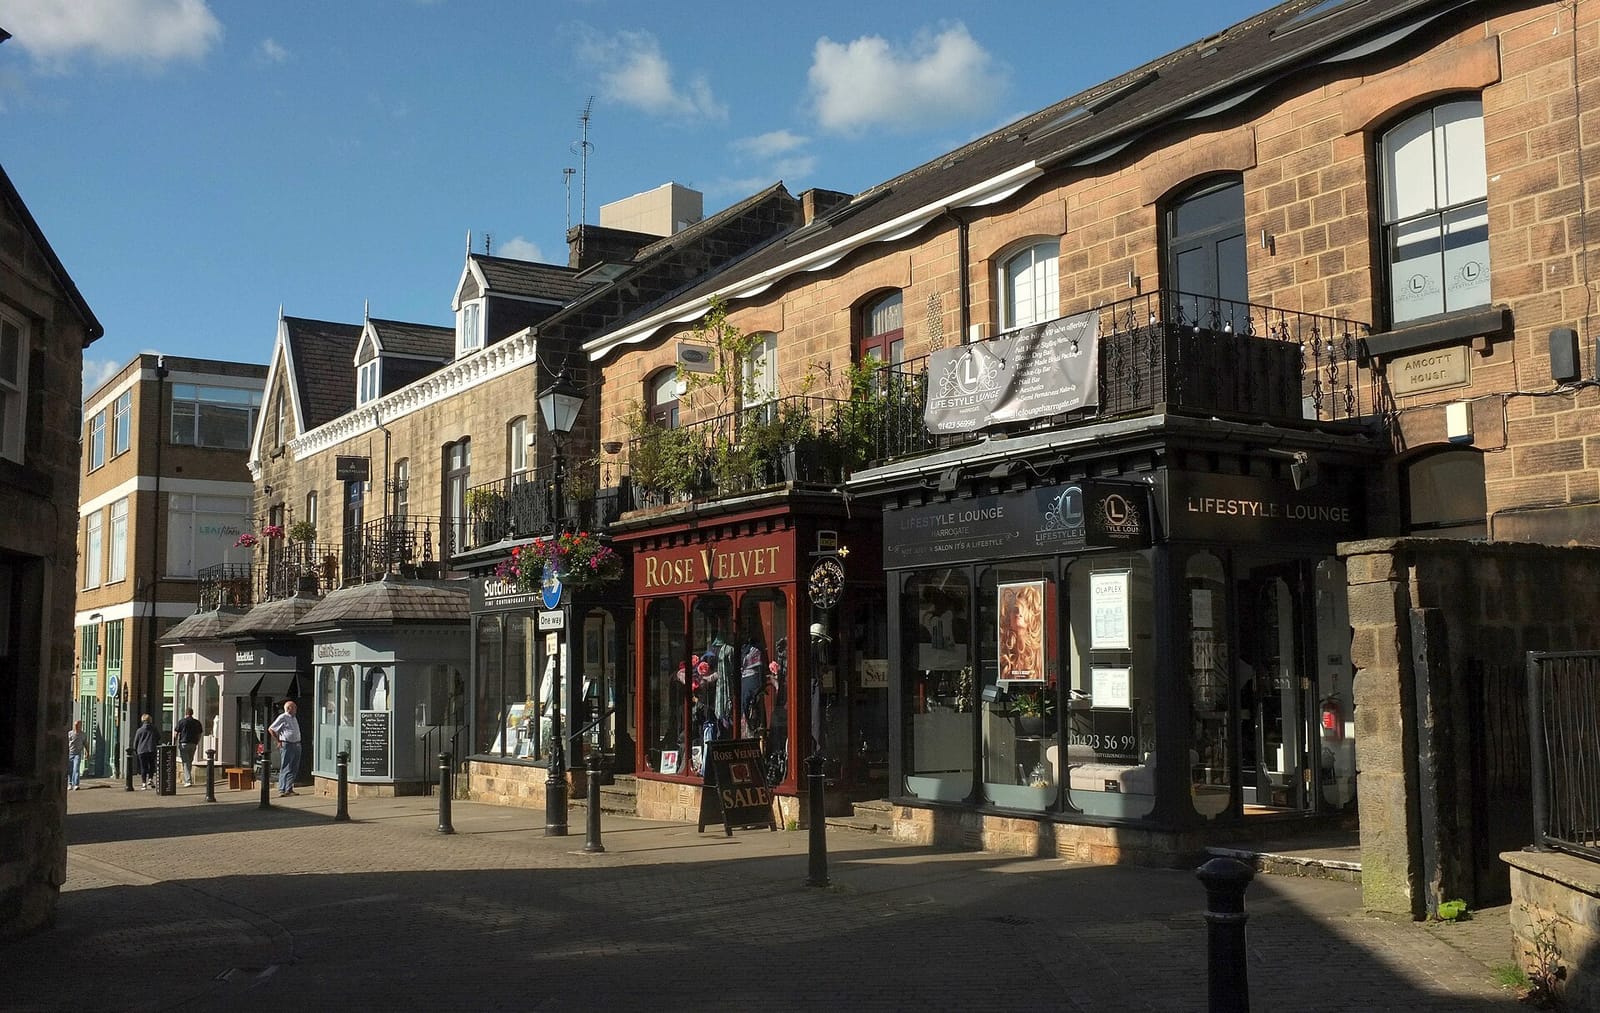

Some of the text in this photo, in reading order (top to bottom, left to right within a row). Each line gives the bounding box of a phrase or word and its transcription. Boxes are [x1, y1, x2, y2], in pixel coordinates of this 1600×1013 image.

[1405, 354, 1452, 371] AMCOTT
[1410, 370, 1447, 384] HOUSE
[1188, 497, 1351, 522] LIFESTYLE LOUNGE
[901, 507, 1004, 530] LIFESTYLE LOUNGE
[1035, 529, 1078, 542] LIFESTYLE
[934, 544, 954, 553] SALON
[972, 538, 1004, 549] LIFESTYLE
[1096, 585, 1122, 594] OLAPLEX
[541, 616, 562, 626] One way
[865, 668, 888, 682] SAL
[1069, 734, 1100, 749] 01423
[1104, 735, 1118, 750] 56
[1121, 735, 1136, 750] 99
[722, 787, 769, 809] SALE
